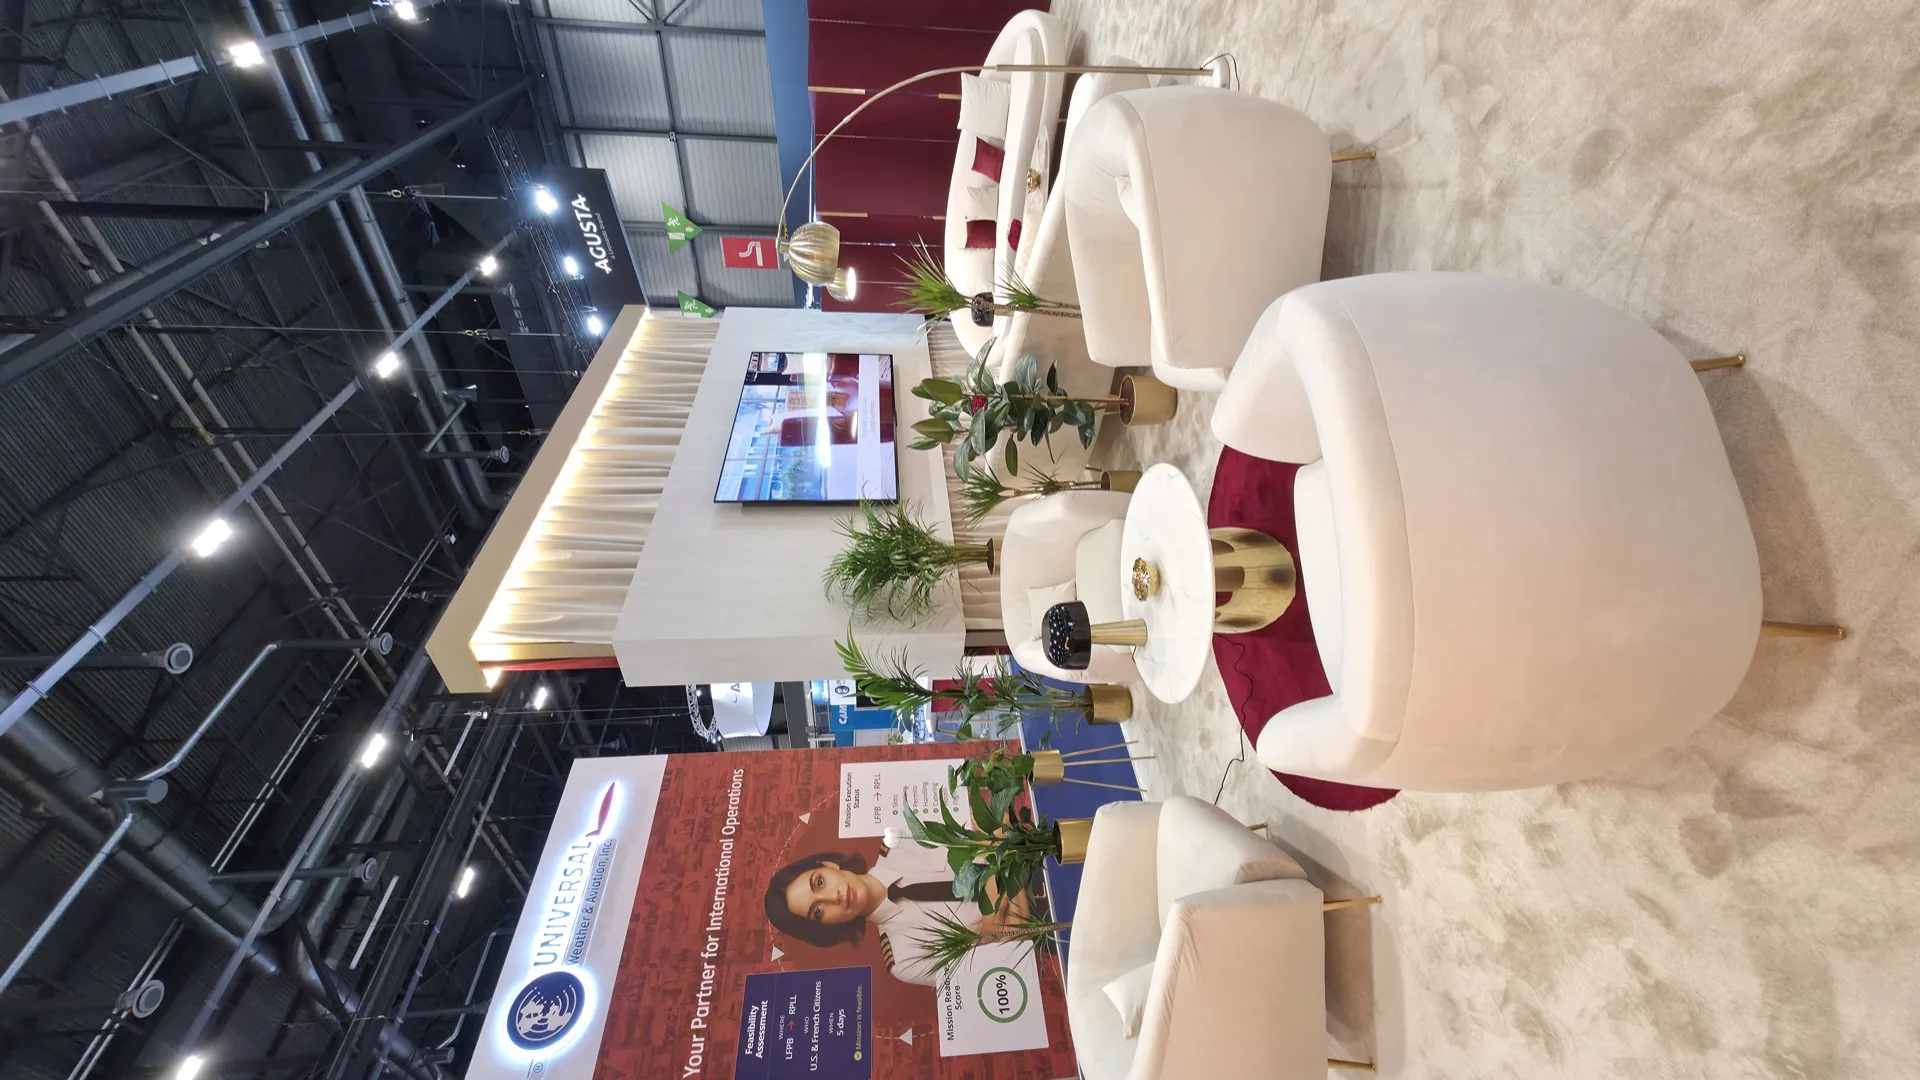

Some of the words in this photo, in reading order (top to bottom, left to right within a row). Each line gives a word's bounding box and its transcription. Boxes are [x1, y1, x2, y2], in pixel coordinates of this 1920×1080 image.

[571, 194, 612, 274] AGUSTA
[722, 769, 744, 835] Operations
[599, 839, 613, 856] Inc.
[586, 858, 609, 903] Aviation,
[706, 838, 734, 930] International
[534, 841, 592, 966] UNIVERSAL
[582, 906, 594, 914] &
[564, 916, 590, 965] Weather
[700, 935, 720, 958] for
[690, 962, 715, 1029] Partner
[788, 994, 797, 1014] RPLL
[813, 981, 822, 1012] Citizens
[954, 985, 962, 1010] Score
[996, 974, 1010, 1014] 100%
[745, 1005, 760, 1055] Feasibility
[756, 1000, 768, 1058] Assessment
[778, 1014, 786, 1040] WHERE
[812, 1014, 820, 1042] French
[837, 1009, 846, 1028] days
[946, 1005, 954, 1040] Mission
[682, 1035, 705, 1078] Your
[786, 1038, 794, 1060] LFPB
[810, 1054, 818, 1071] U.S.
[811, 1044, 818, 1052] &
